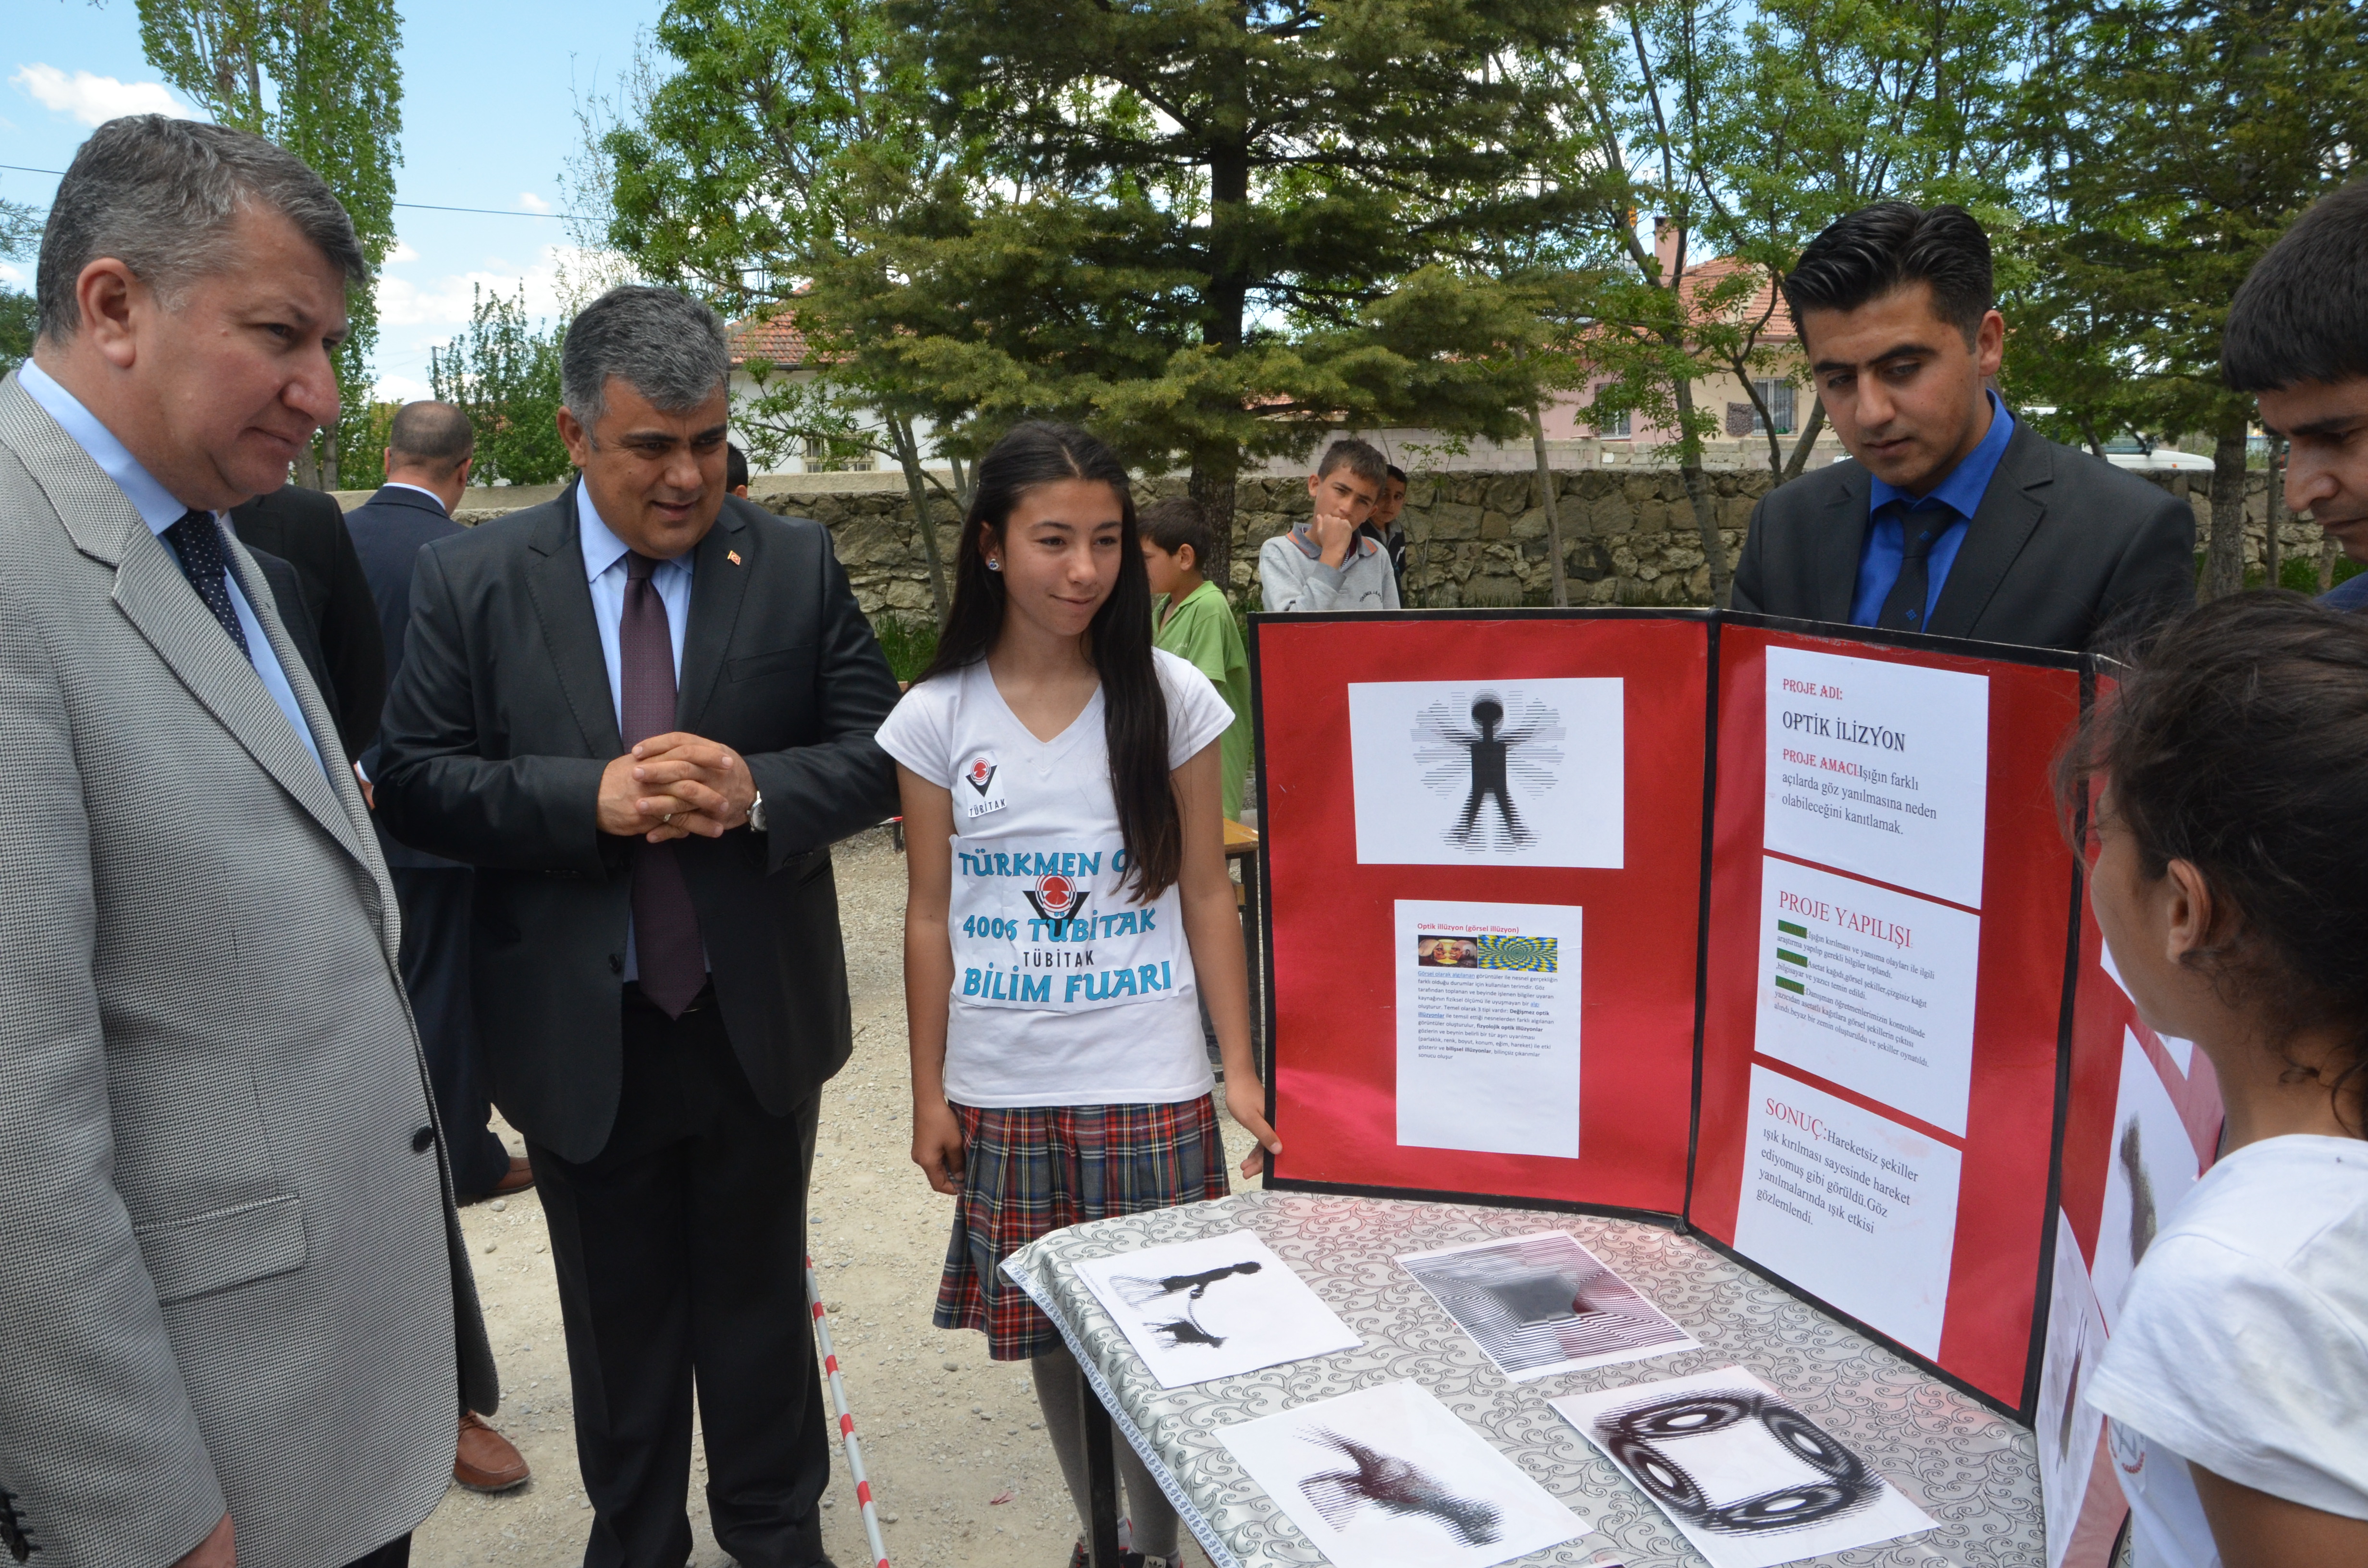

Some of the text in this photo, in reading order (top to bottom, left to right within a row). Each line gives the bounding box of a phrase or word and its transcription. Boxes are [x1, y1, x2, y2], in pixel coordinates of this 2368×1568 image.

[1782, 678, 1842, 700] PROJE ADI:
[1782, 710, 1905, 752] OPTİK İLİZYON
[1782, 748, 1816, 767] PROJE
[1890, 772, 1918, 790] farklı
[969, 798, 1006, 816] TÜBİTAK
[1782, 773, 1936, 819] açılarda göz yanılmasına neden
[1782, 793, 1903, 834] olabileceğini kanıtlamak.
[959, 849, 1103, 877] TÜRKMEN
[1779, 890, 1829, 921] PROJE
[963, 907, 1156, 942] 4006 TÜBİTAK
[1437, 923, 1464, 931] illüzyon
[1490, 925, 1519, 934] illüzyon)
[1023, 949, 1095, 968] TÜBİTAK
[1803, 944, 1823, 956] yapılıp
[1824, 951, 1843, 962] gerekli
[1845, 955, 1865, 969] bilgiler
[1867, 964, 1892, 979] toplandı.
[1860, 949, 1884, 962] yansıma
[1886, 957, 1909, 970] olayları
[1910, 964, 1918, 973] ile
[1920, 967, 1934, 979] ilgili
[963, 961, 1172, 1003] BİLİM FUARI
[1813, 976, 1829, 986] yazıcı
[1831, 981, 1847, 992] temin
[1848, 988, 1866, 1000] edildi.
[1774, 991, 1800, 1004] yazıcıdan
[1801, 1001, 1820, 1012] asetatlı
[1822, 1006, 1846, 1022] kağıtlara
[1847, 1018, 1865, 1029] görsel
[1895, 1036, 1913, 1047] çıktısı
[1911, 995, 1926, 1008] kağıt
[1807, 1014, 1815, 1023] bir
[1816, 1019, 1833, 1030] zemin
[1835, 1025, 1867, 1043] oluşturuldu
[1877, 1042, 1899, 1055] şekiller
[1900, 1051, 1929, 1067] oynatıldı.
[1888, 1017, 1925, 1038] kontrolünde
[1761, 1149, 1887, 1217] ediyomuş gibi görüldü.Göz
[1763, 1128, 1910, 1205] ışık kırılması sayesinde hareket
[1880, 1158, 1918, 1182] şekiller
[1756, 1189, 1813, 1225] gözlemlendi.
[1758, 1168, 1874, 1234] yanılmalarında ışık etkisi
